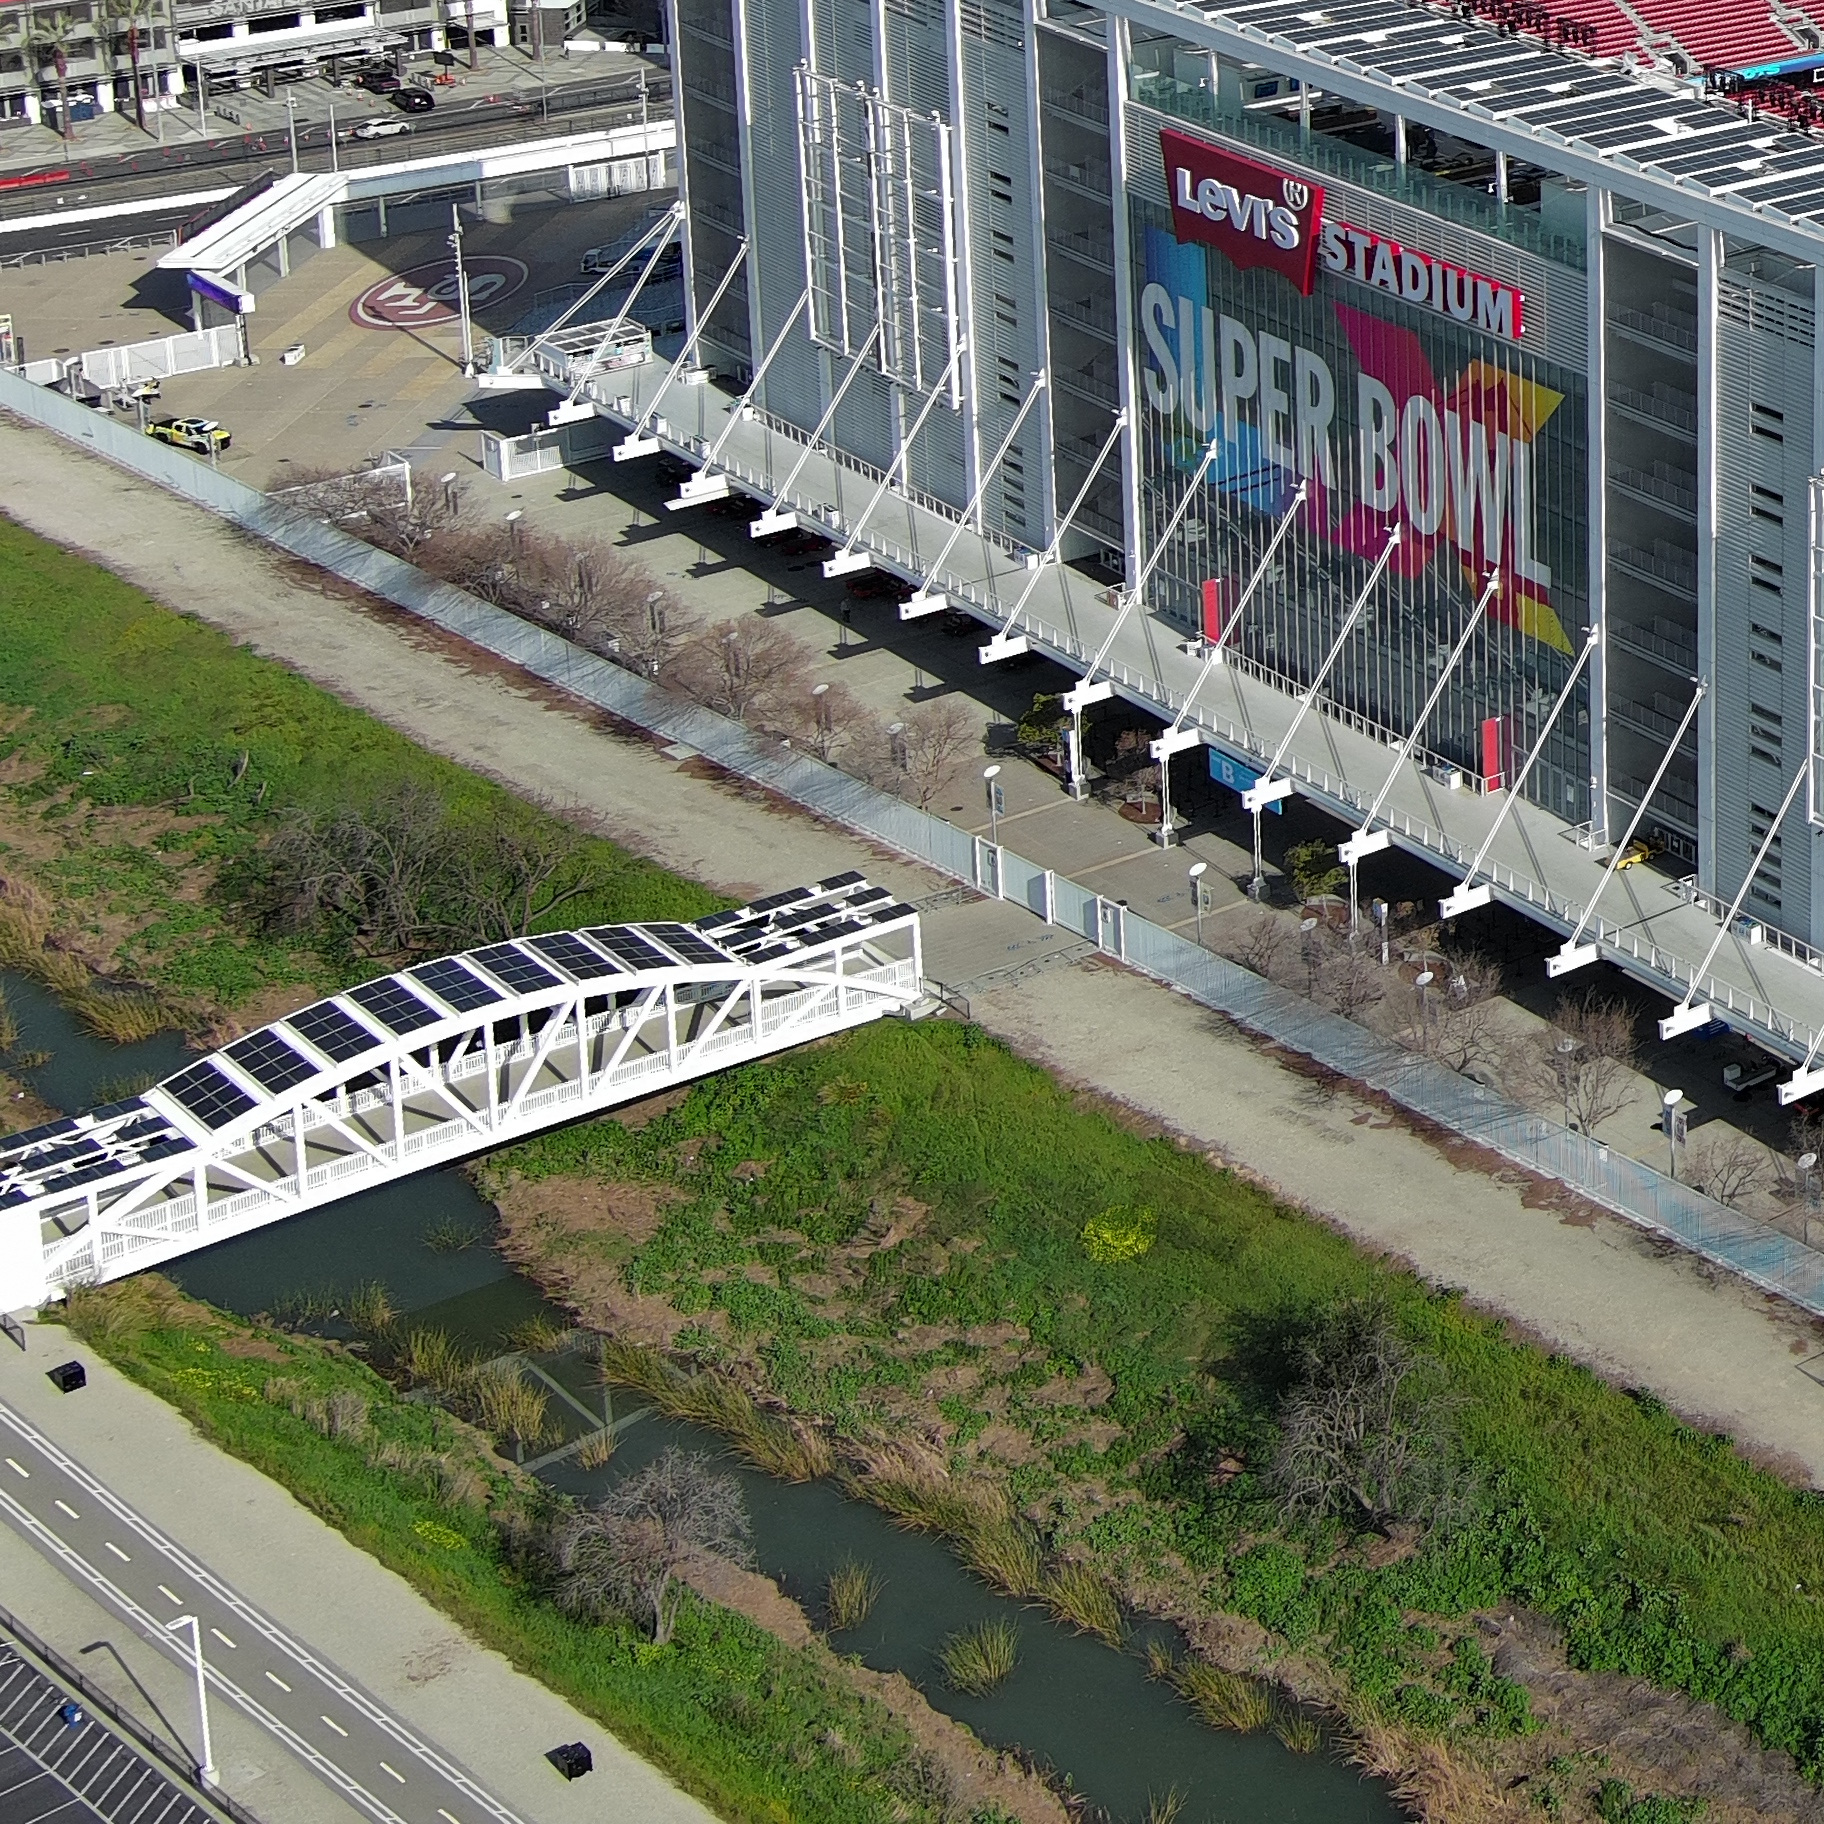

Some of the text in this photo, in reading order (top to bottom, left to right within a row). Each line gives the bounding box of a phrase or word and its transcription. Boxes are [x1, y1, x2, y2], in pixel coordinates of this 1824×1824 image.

[1176, 167, 1518, 338] Levi's STADIUM
[1141, 284, 1552, 590] SUPER BOWL
[1222, 760, 1234, 784] B
